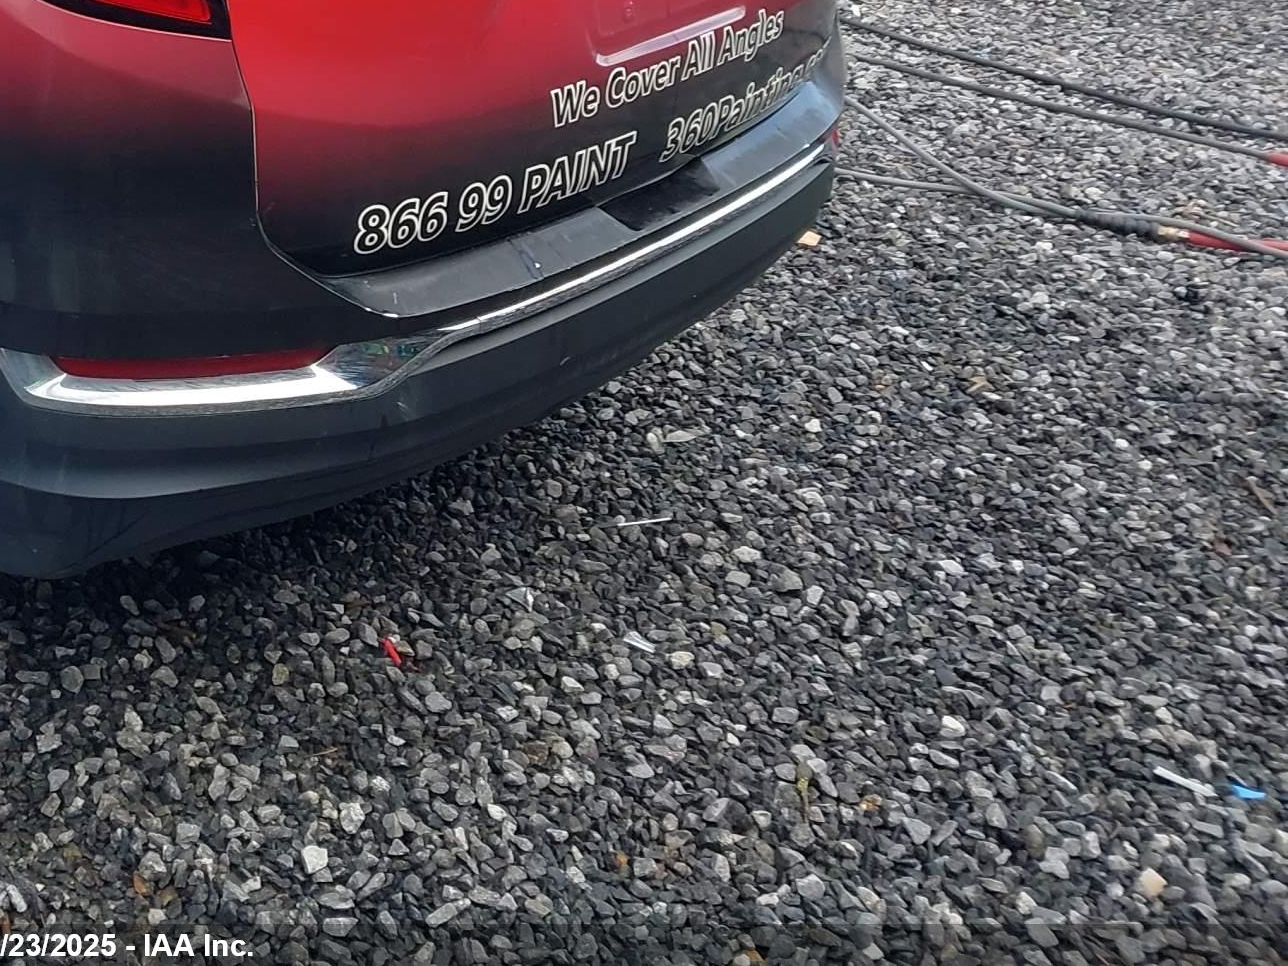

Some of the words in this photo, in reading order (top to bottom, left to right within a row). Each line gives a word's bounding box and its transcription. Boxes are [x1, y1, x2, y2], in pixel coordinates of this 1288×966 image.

[551, 80, 601, 128] We
[605, 54, 681, 109] Cover
[680, 30, 716, 81] All
[716, 8, 785, 66] Angles
[353, 191, 449, 254] 866
[455, 175, 513, 232] 99
[516, 130, 638, 215] PAINT
